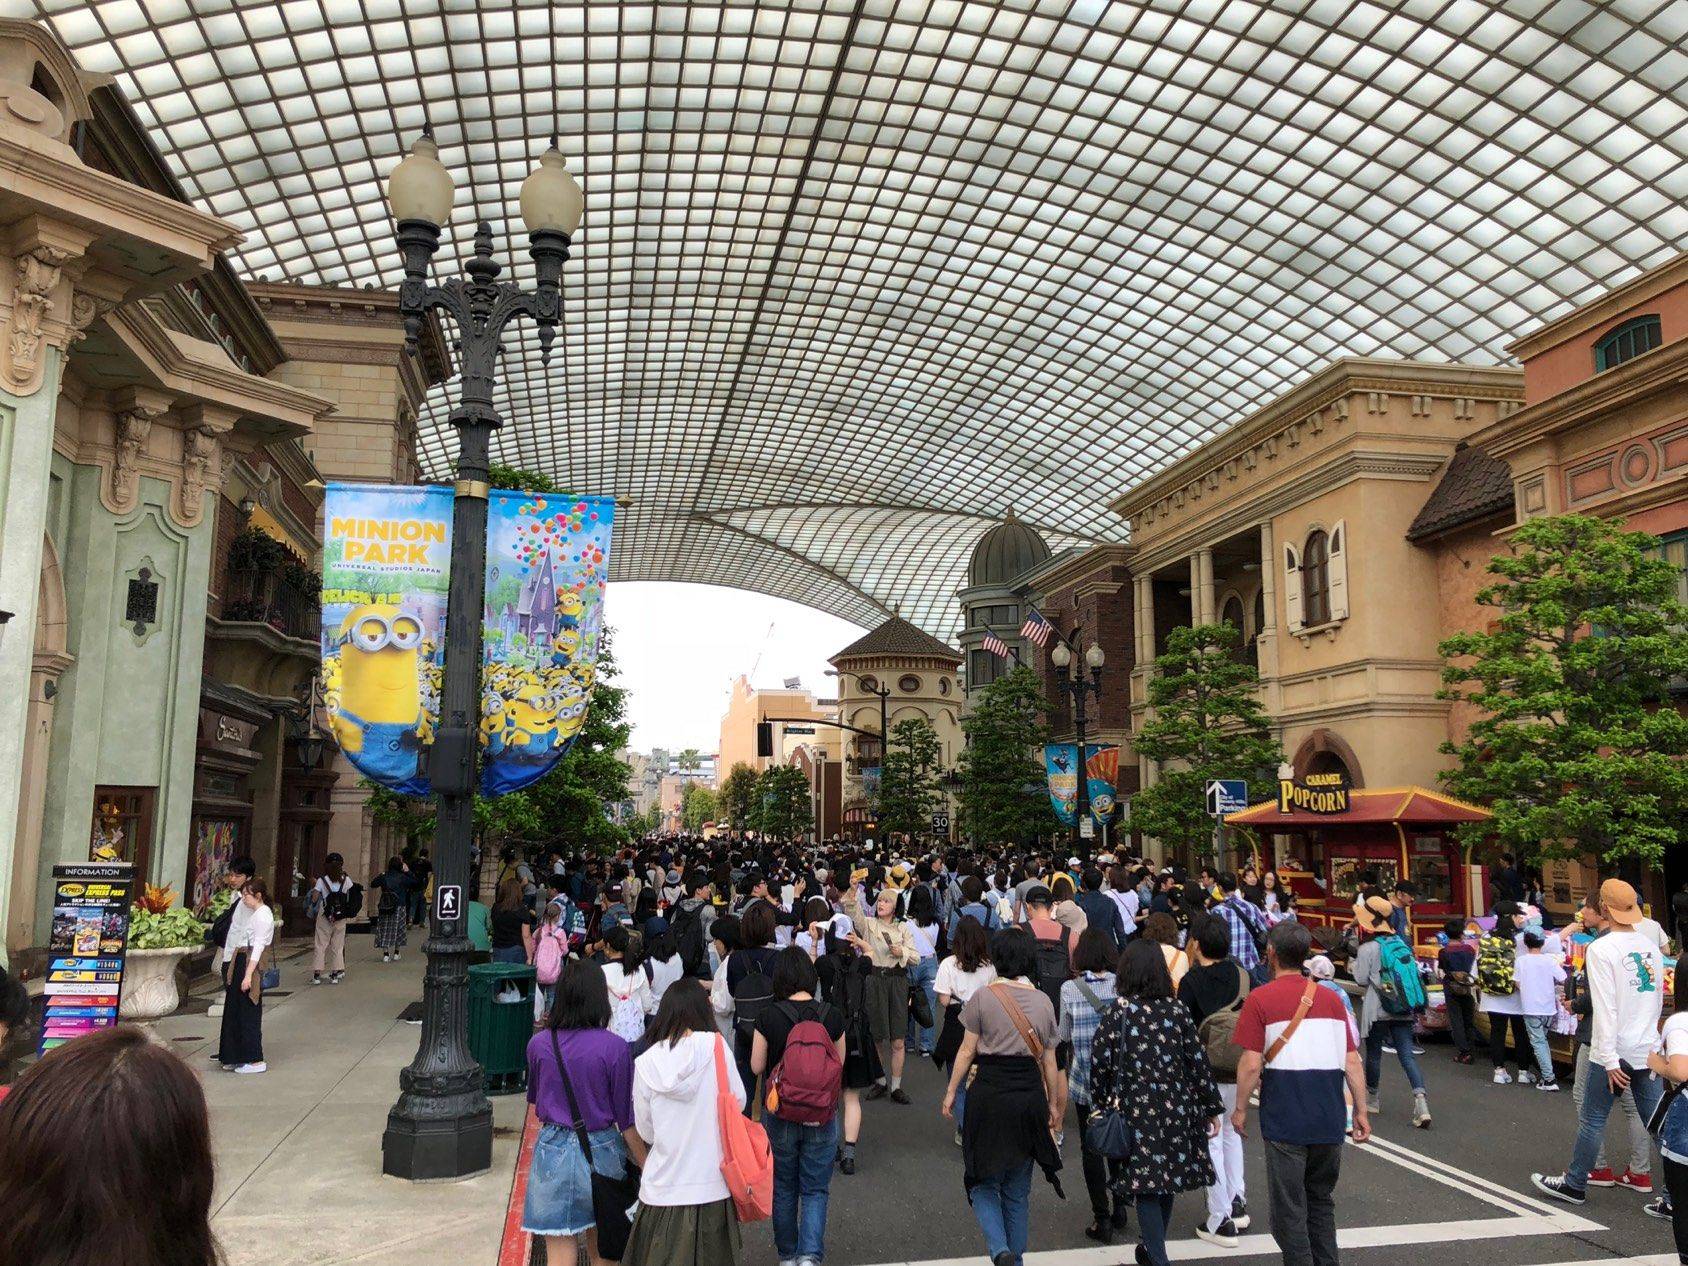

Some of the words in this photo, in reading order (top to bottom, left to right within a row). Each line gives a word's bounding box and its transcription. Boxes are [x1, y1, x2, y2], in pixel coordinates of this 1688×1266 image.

[331, 518, 446, 543] MINION
[344, 541, 429, 564] PARK
[332, 563, 377, 571] UNIVERSAL
[1306, 774, 1342, 785] CARAMEL
[1281, 781, 1346, 812] POPCORN
[933, 817, 948, 827] 30
